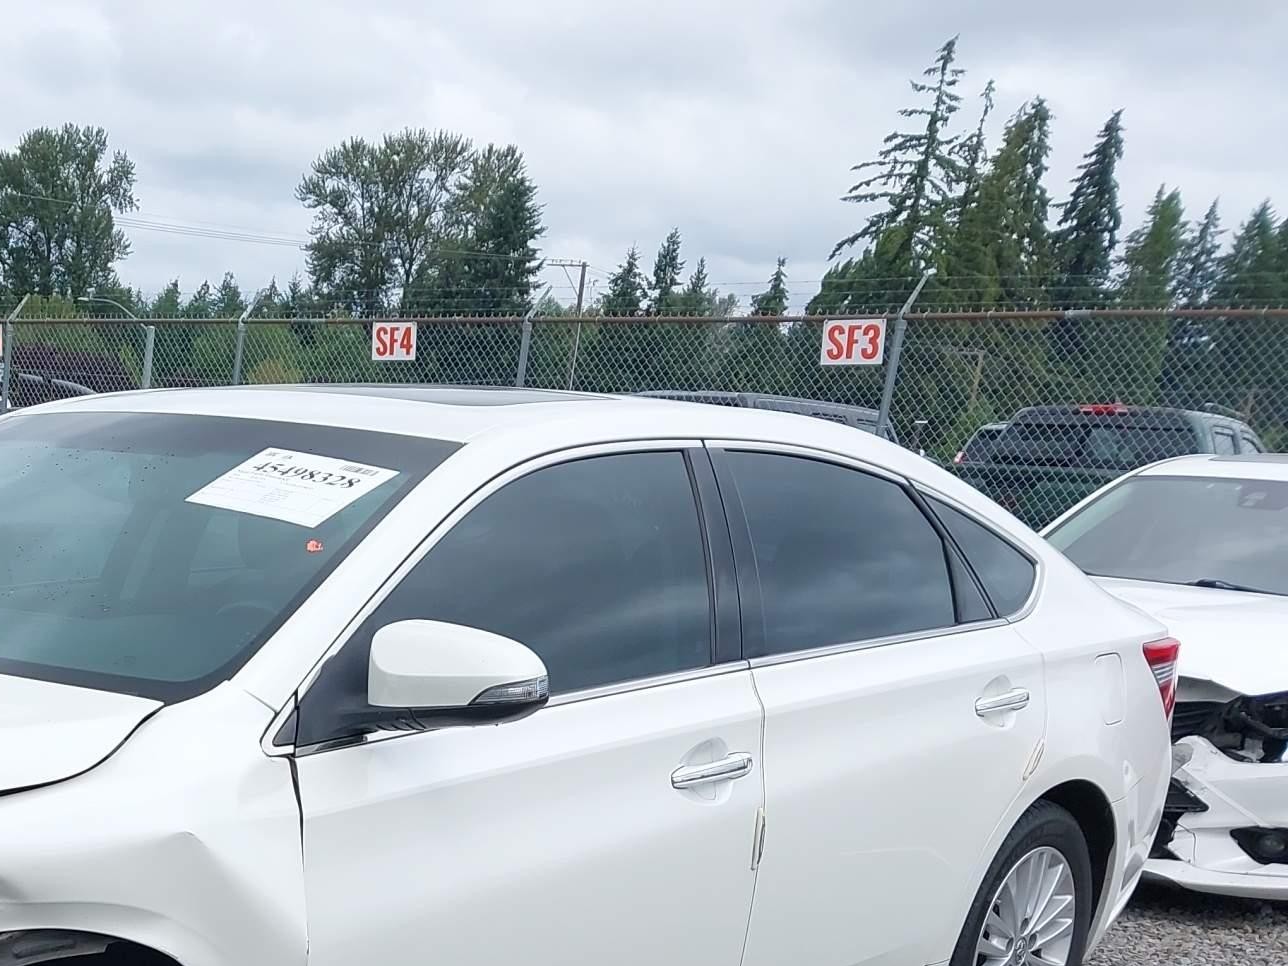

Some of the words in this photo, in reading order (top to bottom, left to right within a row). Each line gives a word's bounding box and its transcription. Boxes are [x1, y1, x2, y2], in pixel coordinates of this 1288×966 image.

[376, 326, 413, 357] SF4
[826, 324, 881, 361] SF3
[251, 461, 361, 489] 45498328
